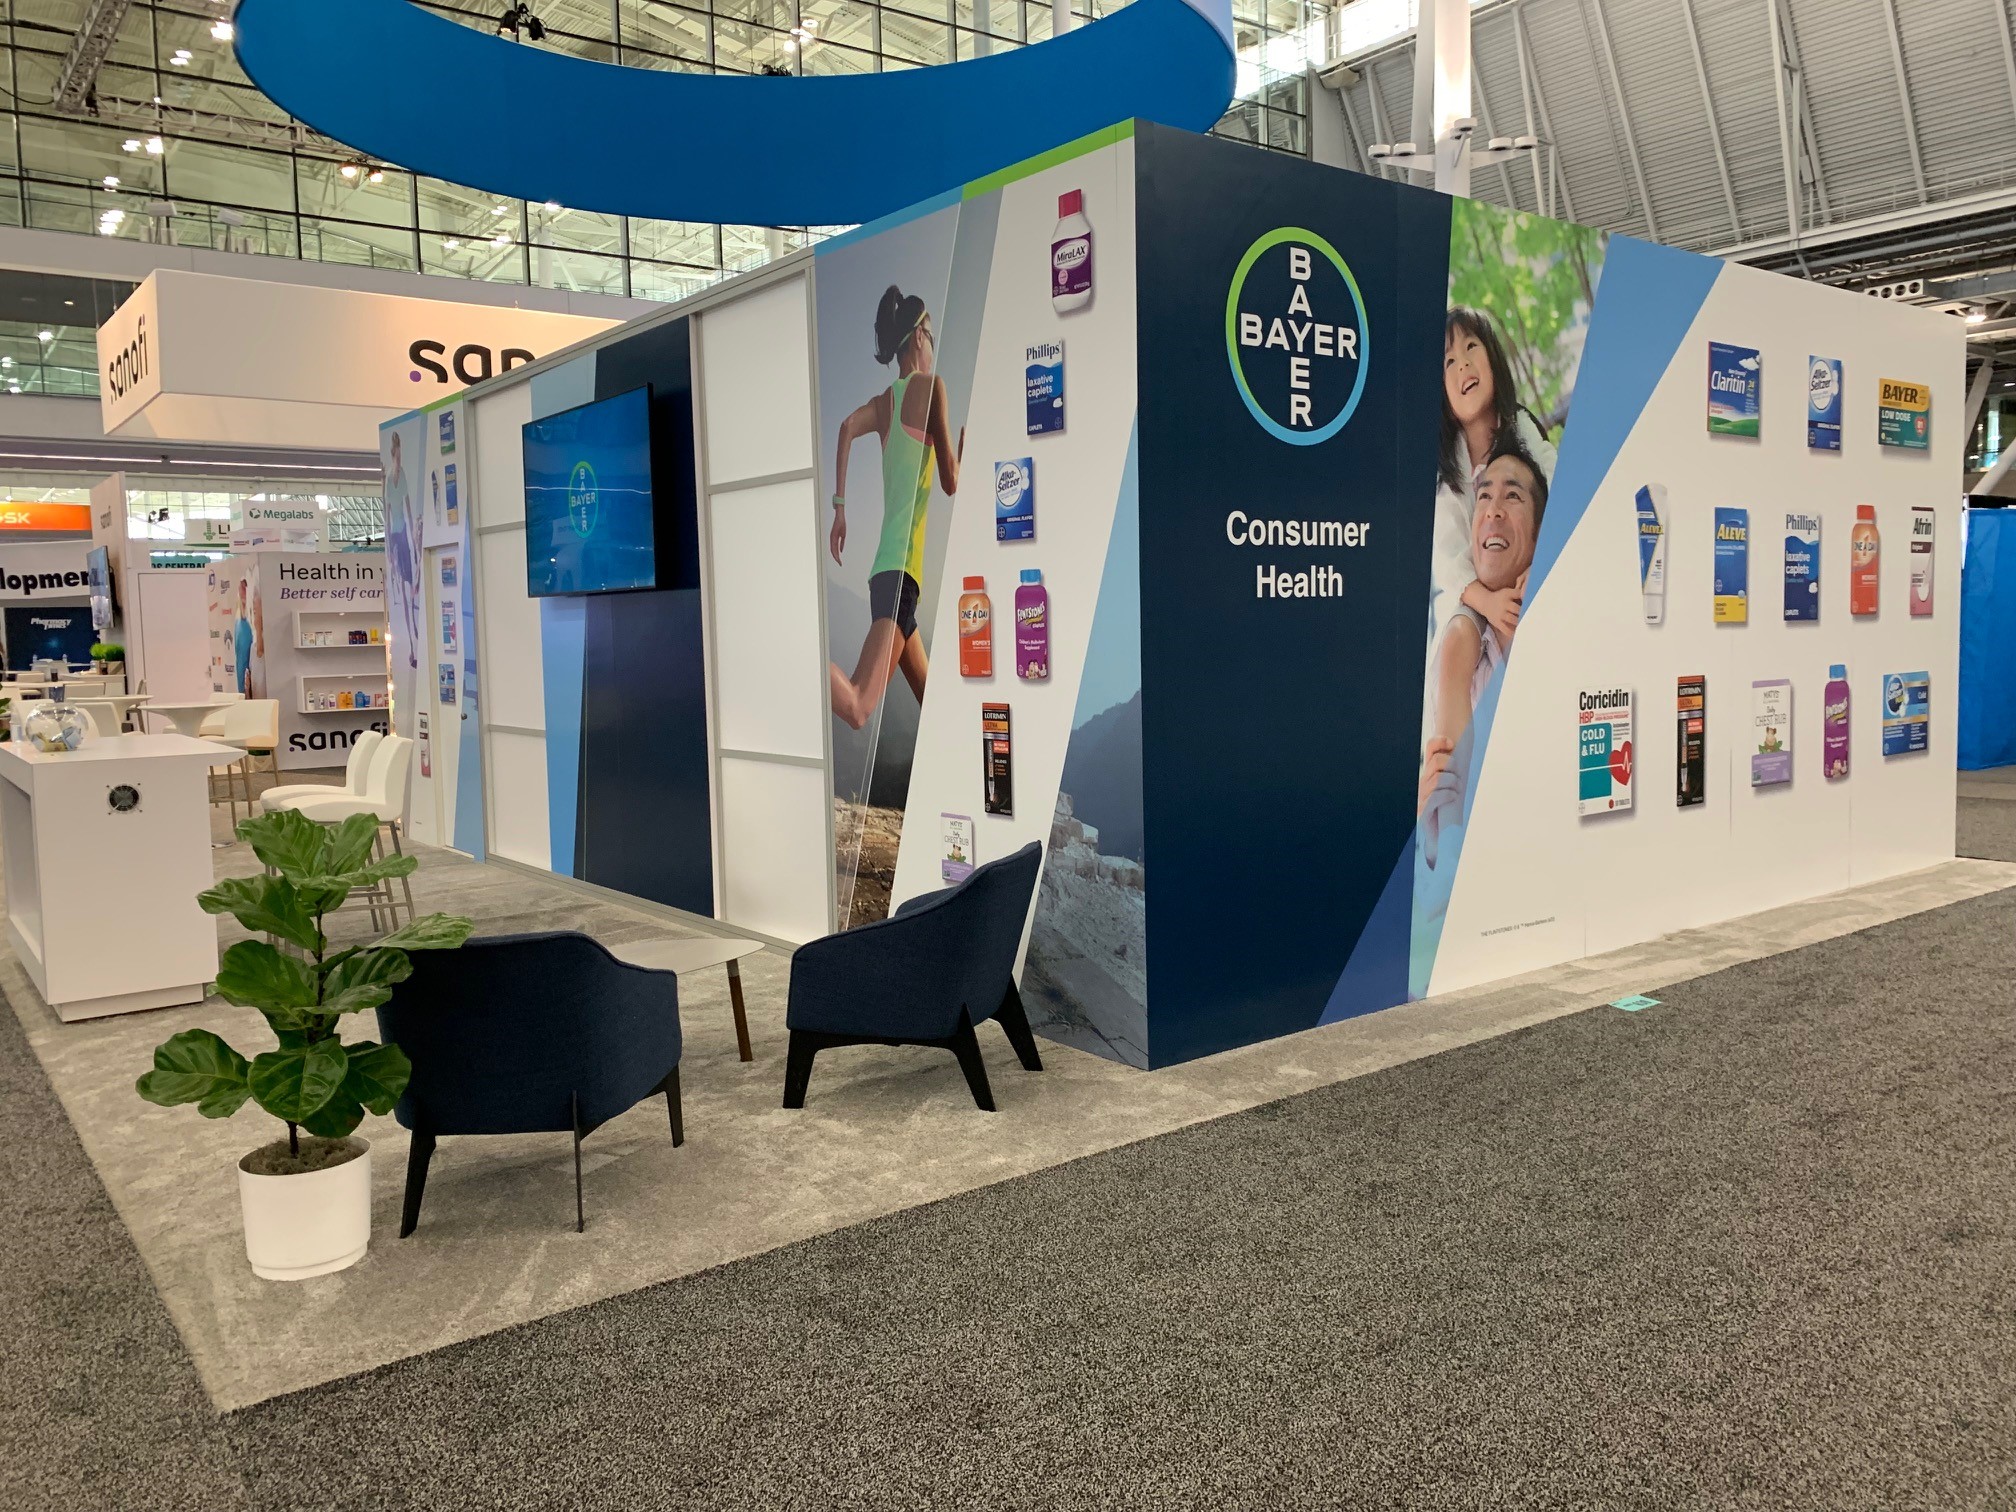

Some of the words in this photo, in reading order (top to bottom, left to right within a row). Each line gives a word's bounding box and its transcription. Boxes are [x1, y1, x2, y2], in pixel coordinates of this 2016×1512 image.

[1056, 244, 1087, 262] MiraLAX
[1240, 312, 1357, 360] BAYER
[1288, 247, 1313, 427] BAYER
[109, 313, 149, 406] sanofi
[409, 339, 536, 386] san
[1027, 374, 1054, 387] laxative
[1711, 370, 1746, 394] Claritin
[1027, 385, 1053, 398] caplets
[1882, 384, 1918, 404] BAYER
[1881, 410, 1894, 420] LOW
[1895, 411, 1911, 422] DOSE
[571, 491, 596, 507] BAYER
[263, 509, 314, 521] Megalabs
[1226, 510, 1370, 547] Consumer
[1912, 518, 1932, 535] Afrin
[1785, 551, 1811, 562] laxative
[279, 562, 350, 580] Health
[356, 563, 374, 580] in
[1785, 563, 1809, 576] caplets
[1256, 565, 1343, 598] Health
[280, 587, 328, 600] Better
[330, 587, 357, 601] self
[1579, 689, 1629, 711] Coricidin
[984, 712, 1007, 720] LOTRIMIN
[1579, 711, 1595, 724] HBP
[1581, 728, 1606, 742] COLD
[1581, 744, 1589, 757] &
[1589, 742, 1605, 756] FLU
